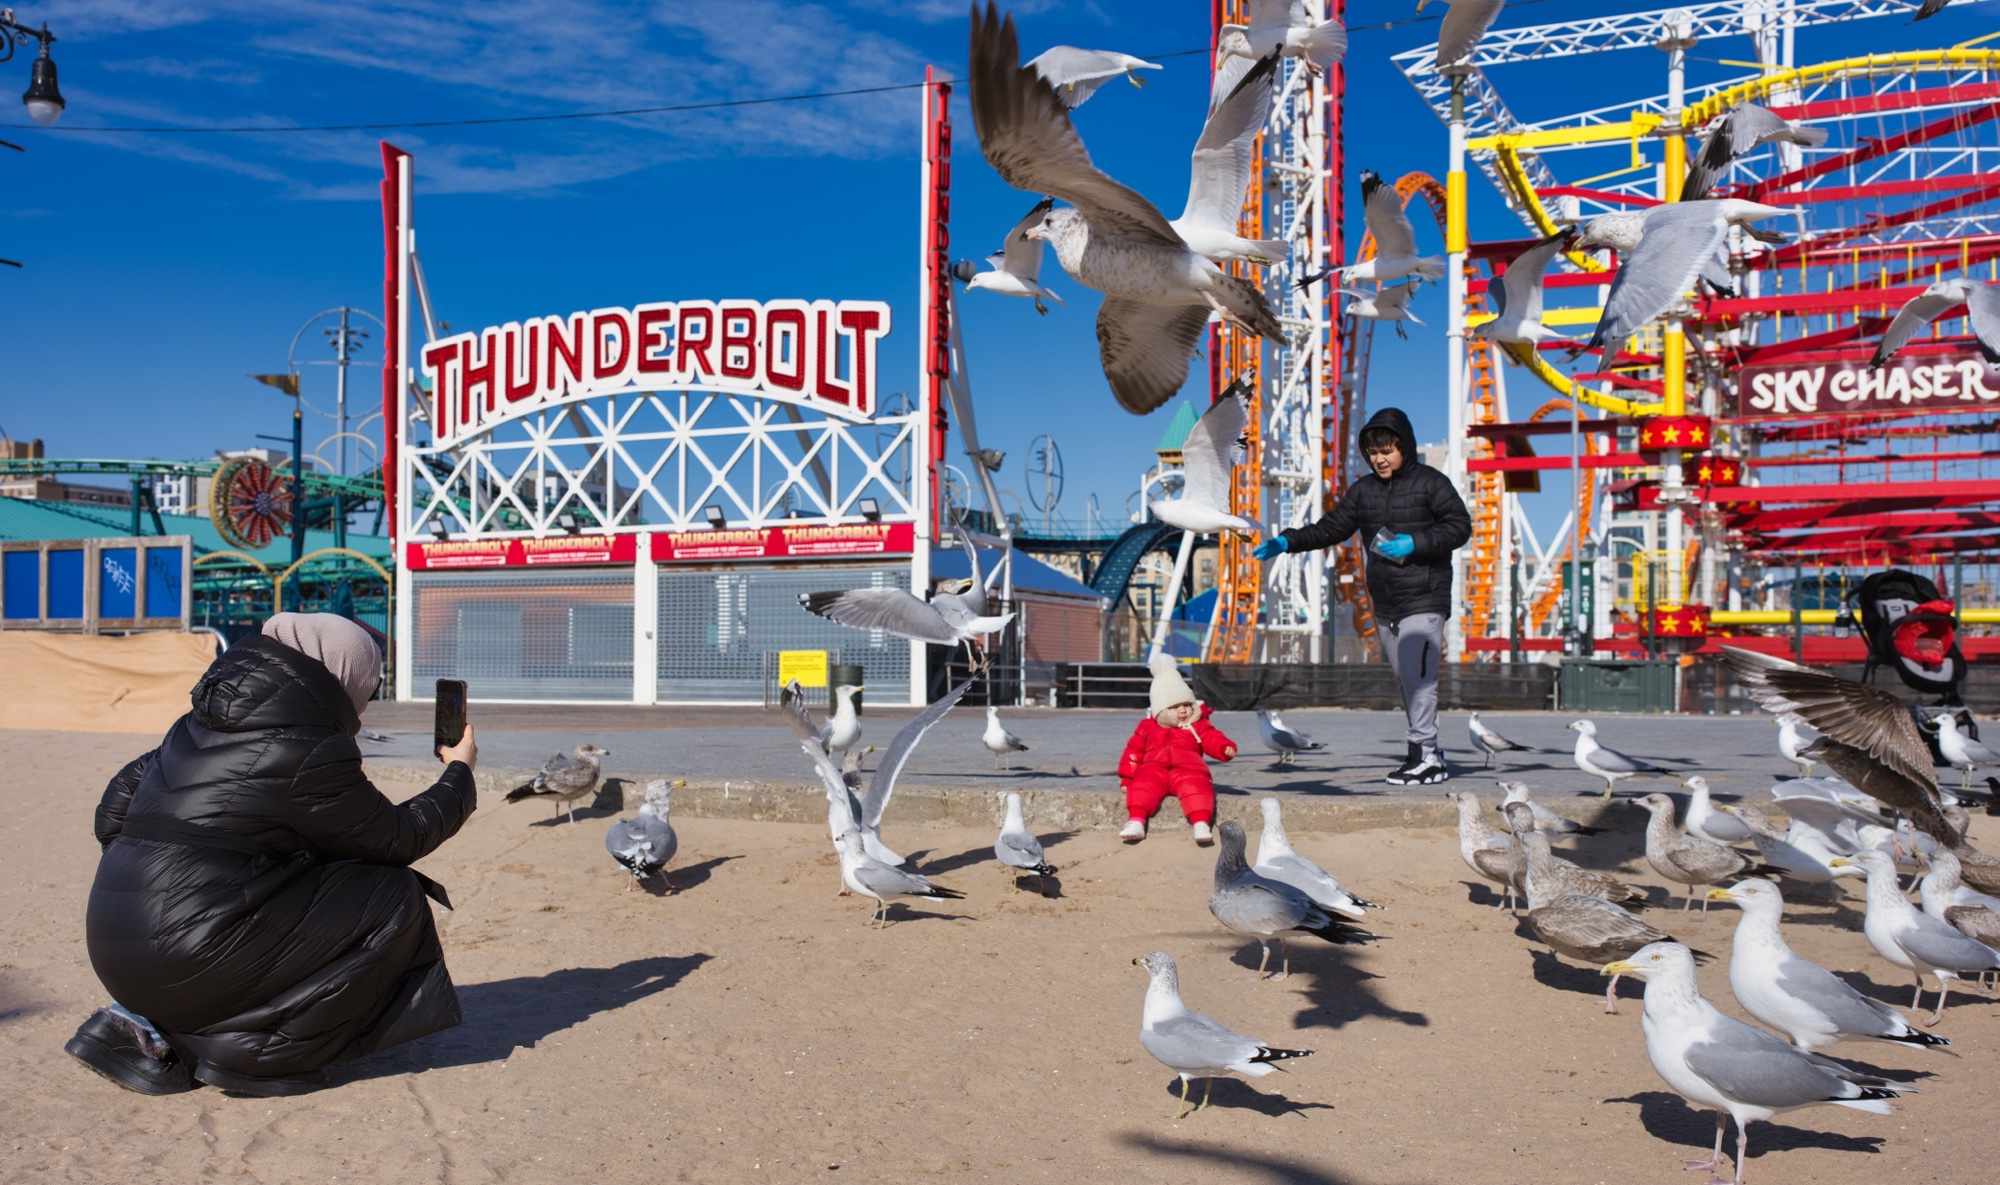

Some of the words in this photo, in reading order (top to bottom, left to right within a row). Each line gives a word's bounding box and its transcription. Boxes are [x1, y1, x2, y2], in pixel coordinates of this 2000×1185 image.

[424, 304, 884, 442] THUNDERBOLT
[1749, 366, 1826, 413] SKY
[1829, 359, 2000, 405] CHASER
[668, 529, 771, 548] THUNDERBOLT
[782, 525, 891, 544] THUNDERBOLT
[421, 540, 512, 558] THUNDERBOLT
[521, 536, 616, 555] THUNDERBOLT
